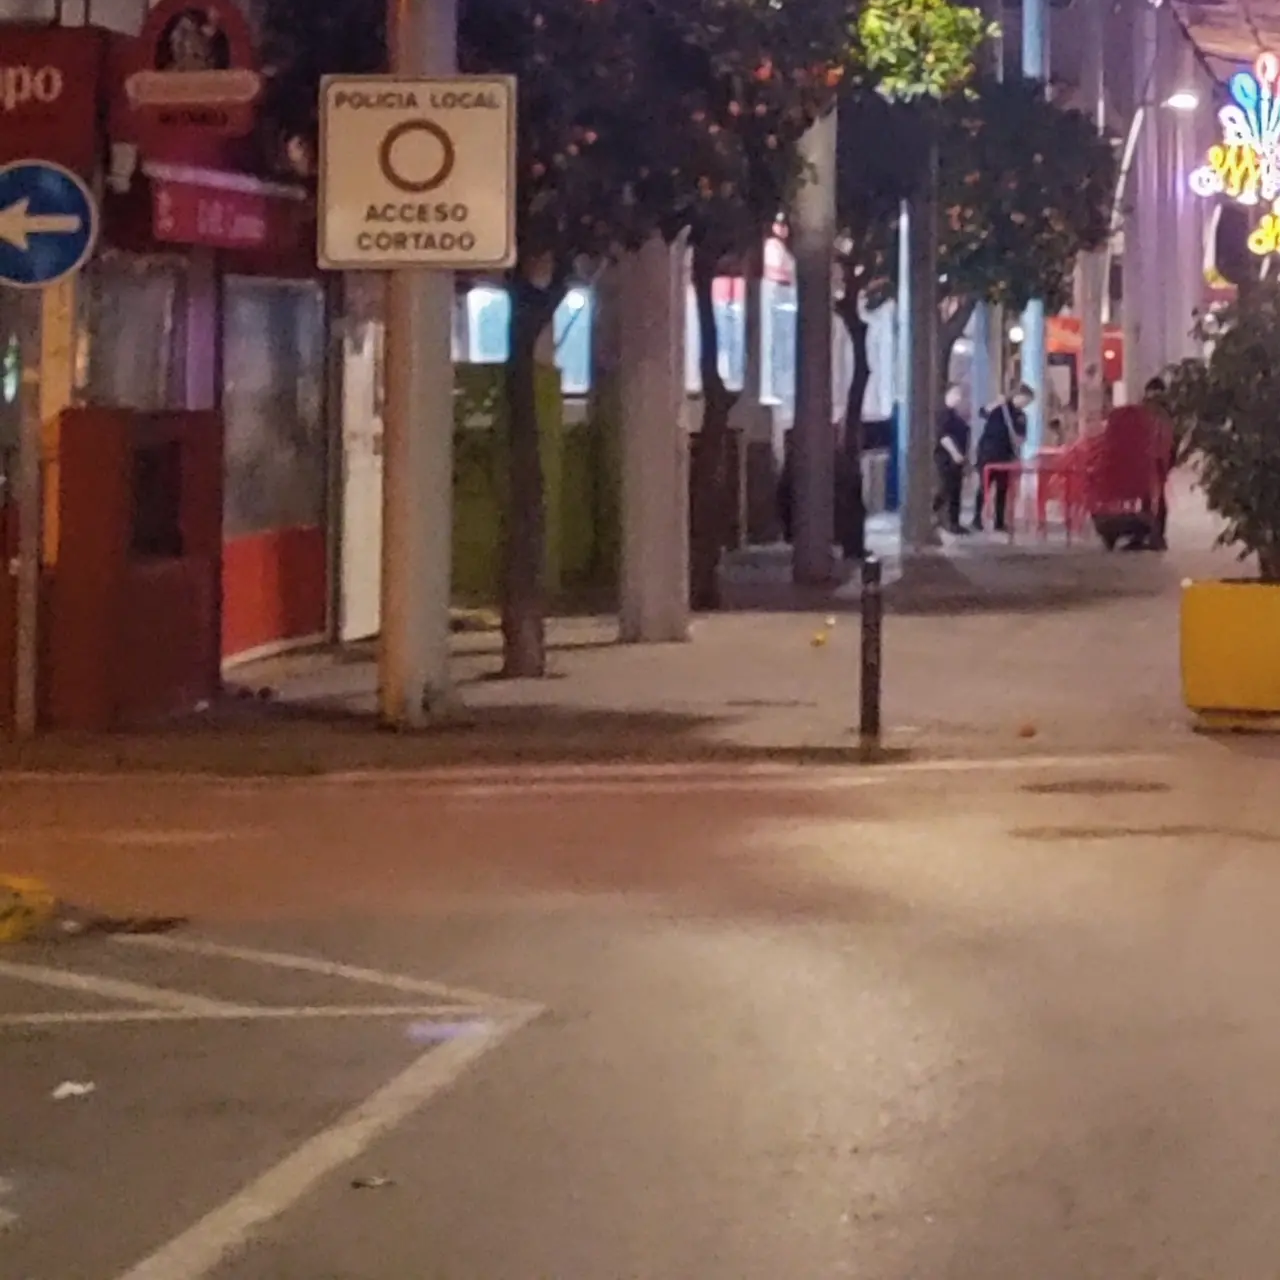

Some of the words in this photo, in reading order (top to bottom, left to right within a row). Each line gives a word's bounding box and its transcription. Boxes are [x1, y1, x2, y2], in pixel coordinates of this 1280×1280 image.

[0, 64, 63, 111] po
[335, 91, 419, 110] POLICIA
[430, 91, 500, 110] LOCAL
[364, 202, 469, 223] ACCESO
[356, 231, 476, 252] CORTADO
